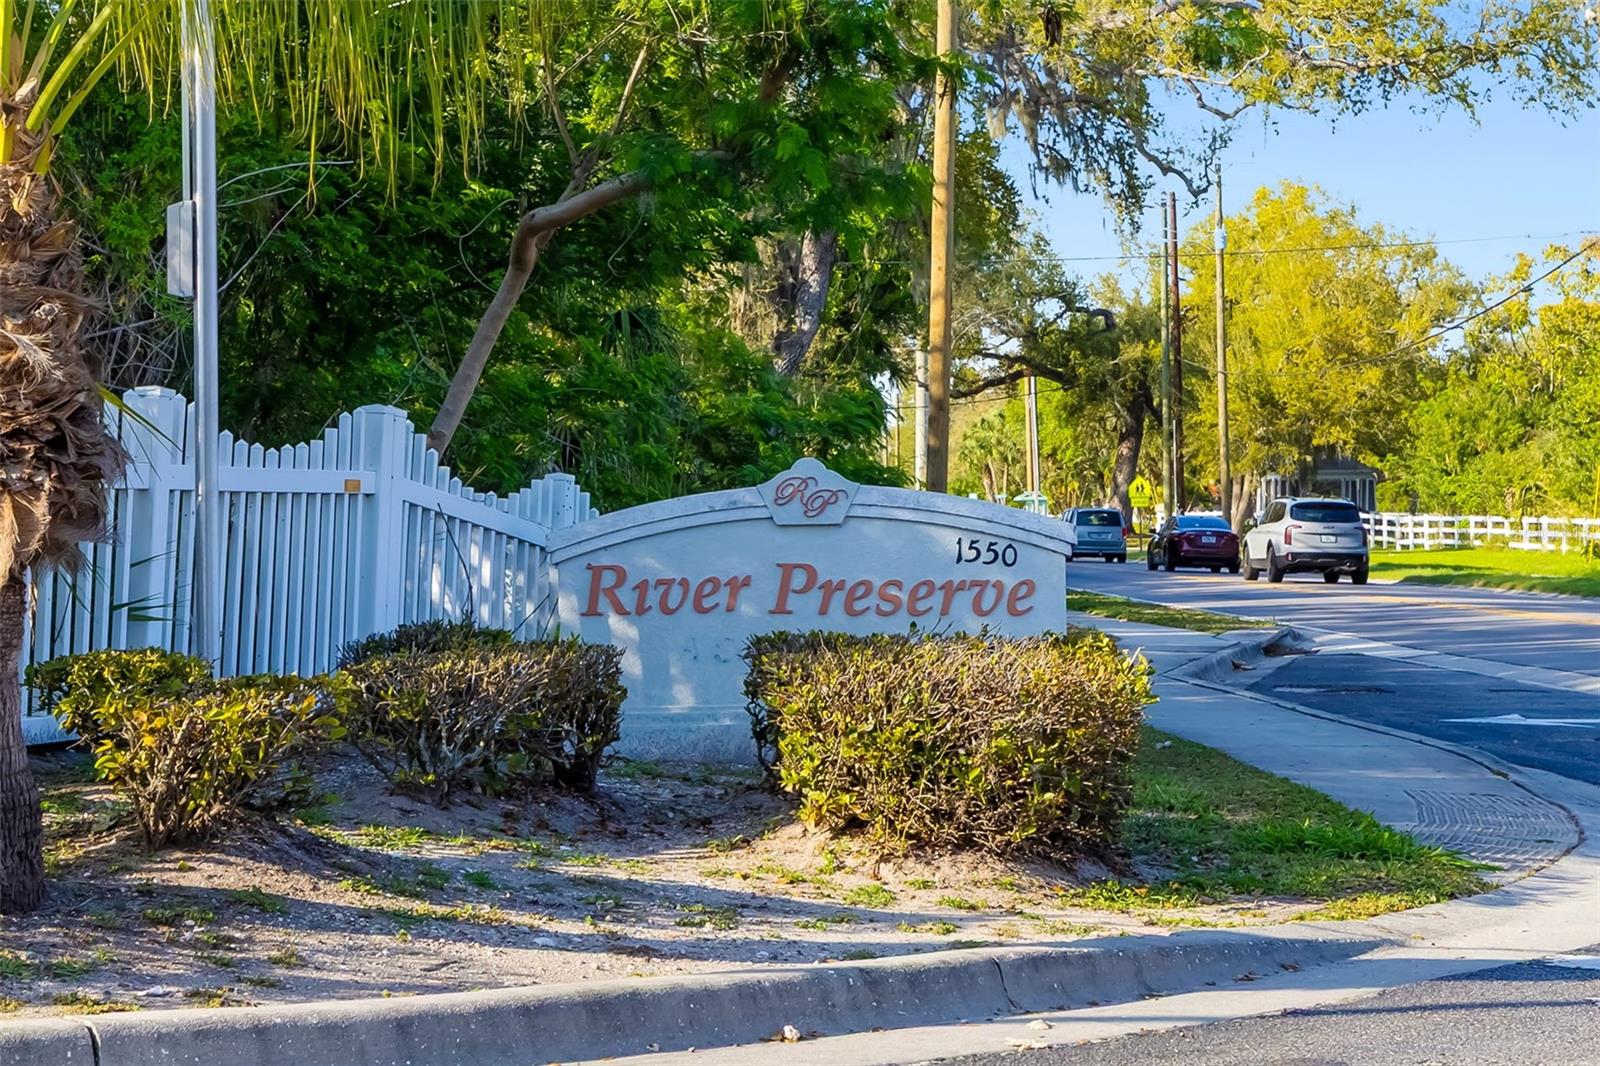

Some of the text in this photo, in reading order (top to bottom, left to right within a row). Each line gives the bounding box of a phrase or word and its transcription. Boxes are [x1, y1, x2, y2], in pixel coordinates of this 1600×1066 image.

[774, 476, 849, 518] RP
[956, 536, 1018, 567] 1550
[581, 562, 1036, 617] River Preserve
